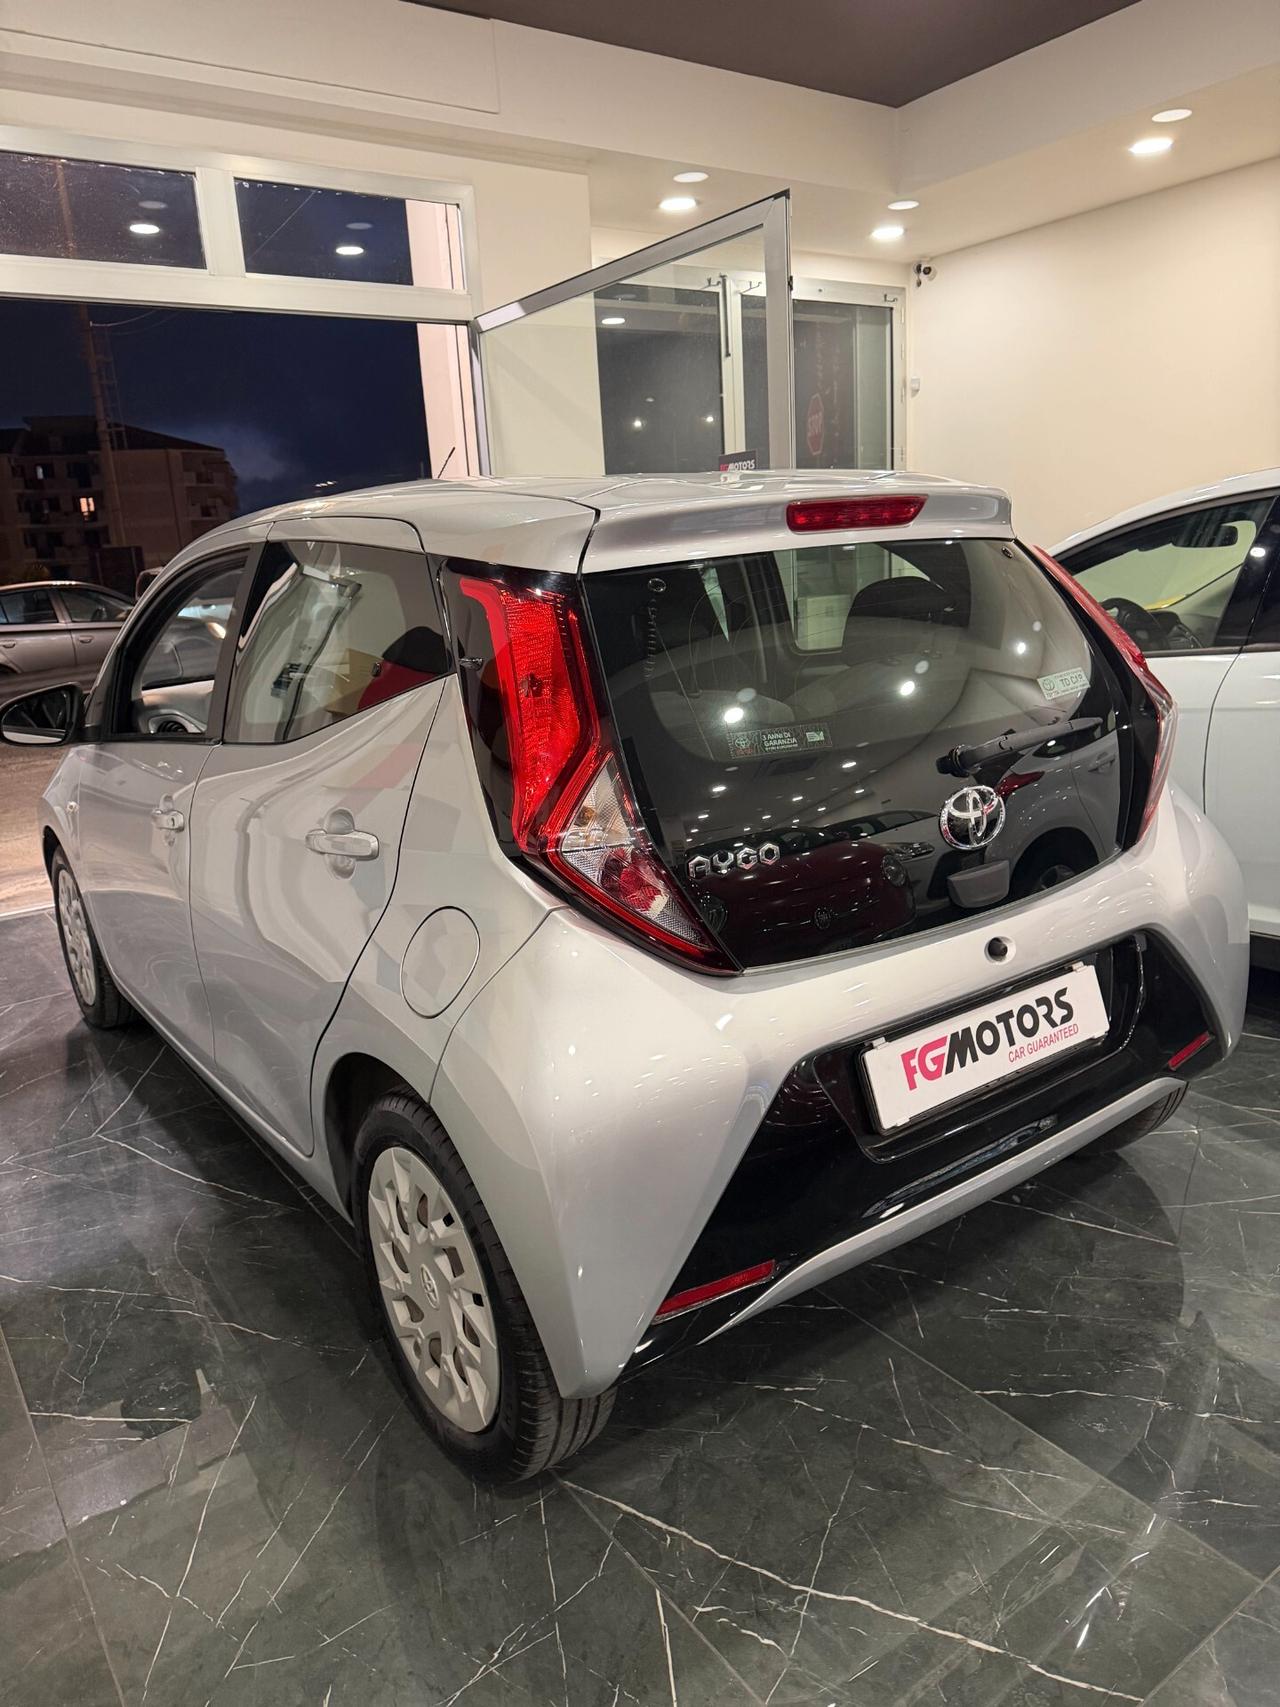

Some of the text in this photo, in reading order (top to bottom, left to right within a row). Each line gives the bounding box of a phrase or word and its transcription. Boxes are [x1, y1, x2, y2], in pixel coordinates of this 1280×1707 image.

[763, 738, 798, 747] GARANZIA
[688, 843, 780, 878] AYGO
[1008, 1023, 1079, 1063] CAR GUARANTEED
